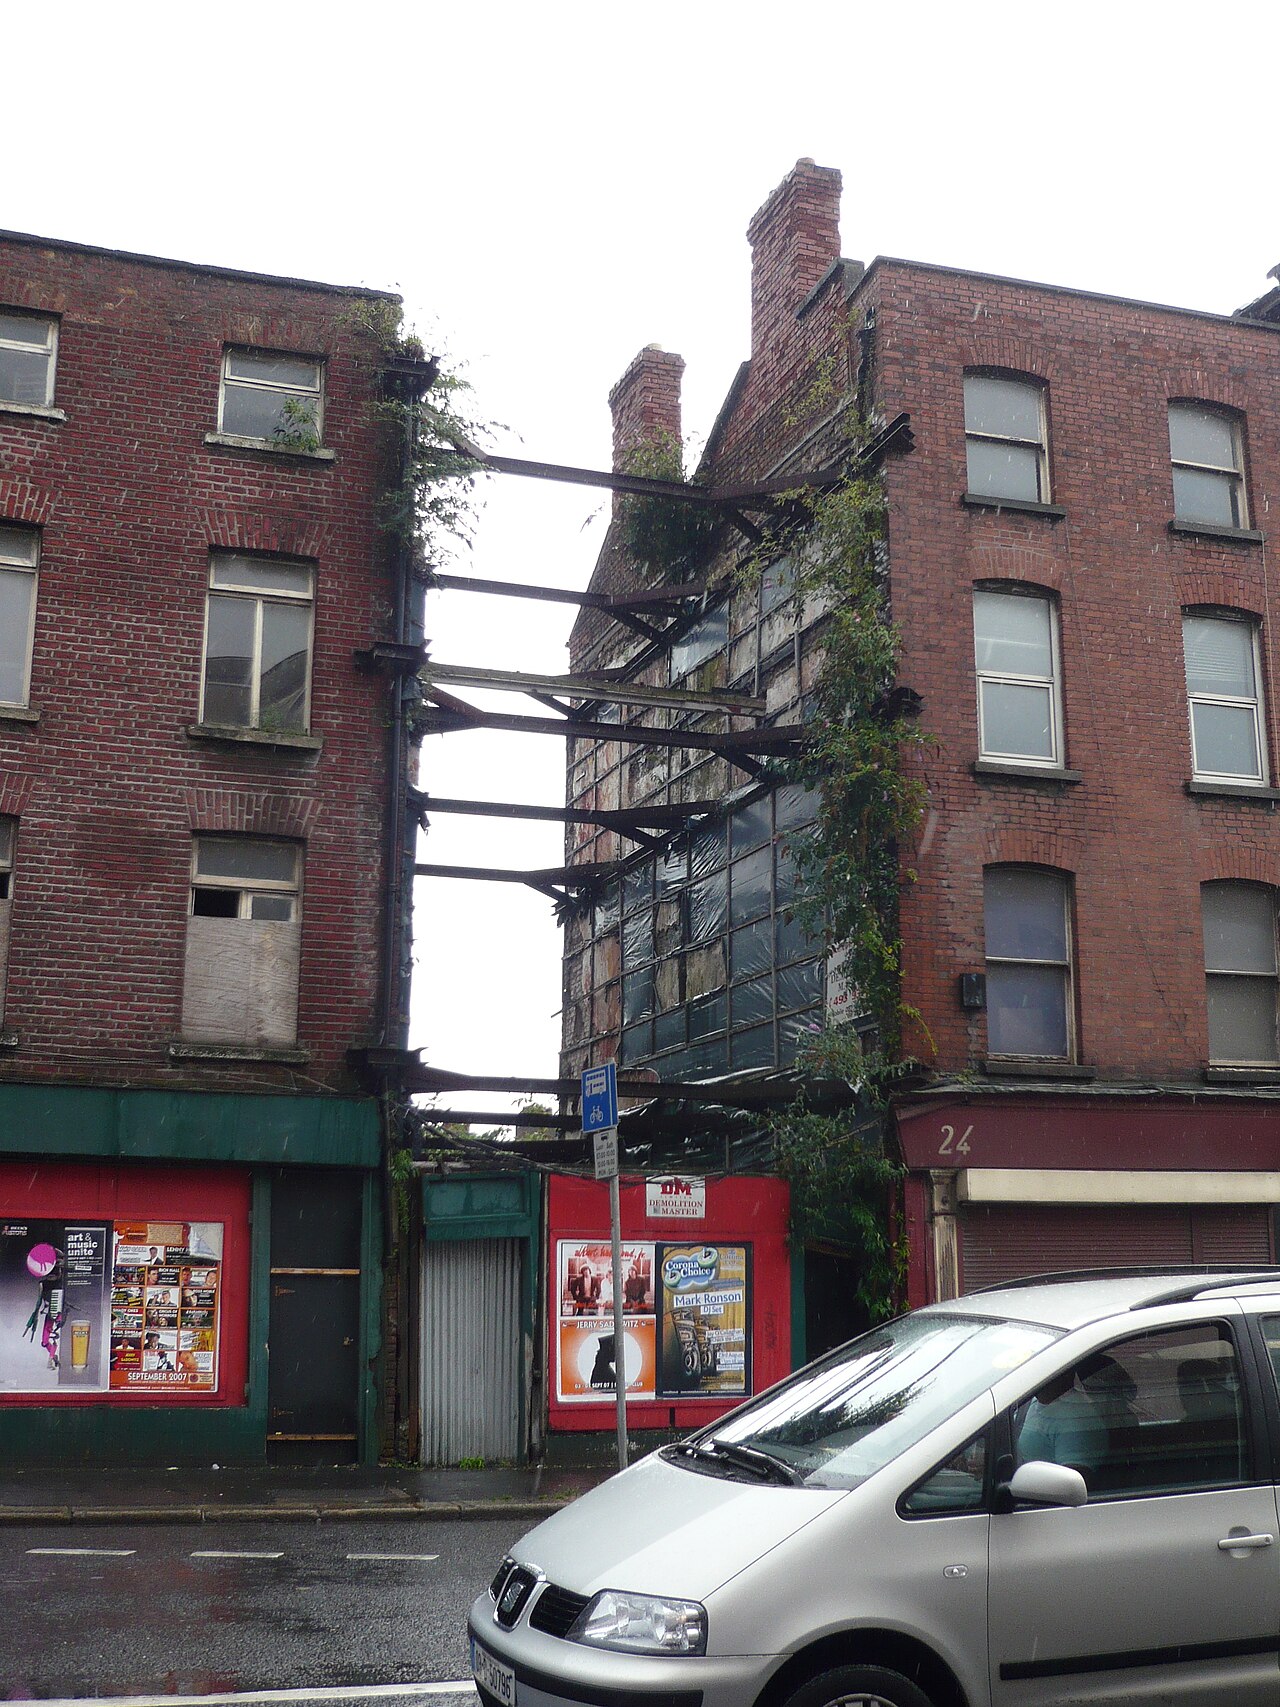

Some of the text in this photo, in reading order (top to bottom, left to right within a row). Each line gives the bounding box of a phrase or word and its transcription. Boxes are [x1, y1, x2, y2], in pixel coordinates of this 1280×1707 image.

[938, 1125, 974, 1155] 24
[661, 1178, 692, 1196] DM
[649, 1200, 703, 1208] DEMOLITION
[68, 1233, 91, 1241] art &
[68, 1241, 98, 1249] music
[68, 1248, 94, 1256] unite
[665, 1261, 699, 1271] Corona
[680, 1267, 711, 1278] Choice
[675, 1292, 741, 1306] Mark Ronson
[703, 1306, 711, 1314] DJ
[576, 1320, 639, 1329] JERRY SADWITZ
[127, 1372, 187, 1381] SEPTEMBER 2007
